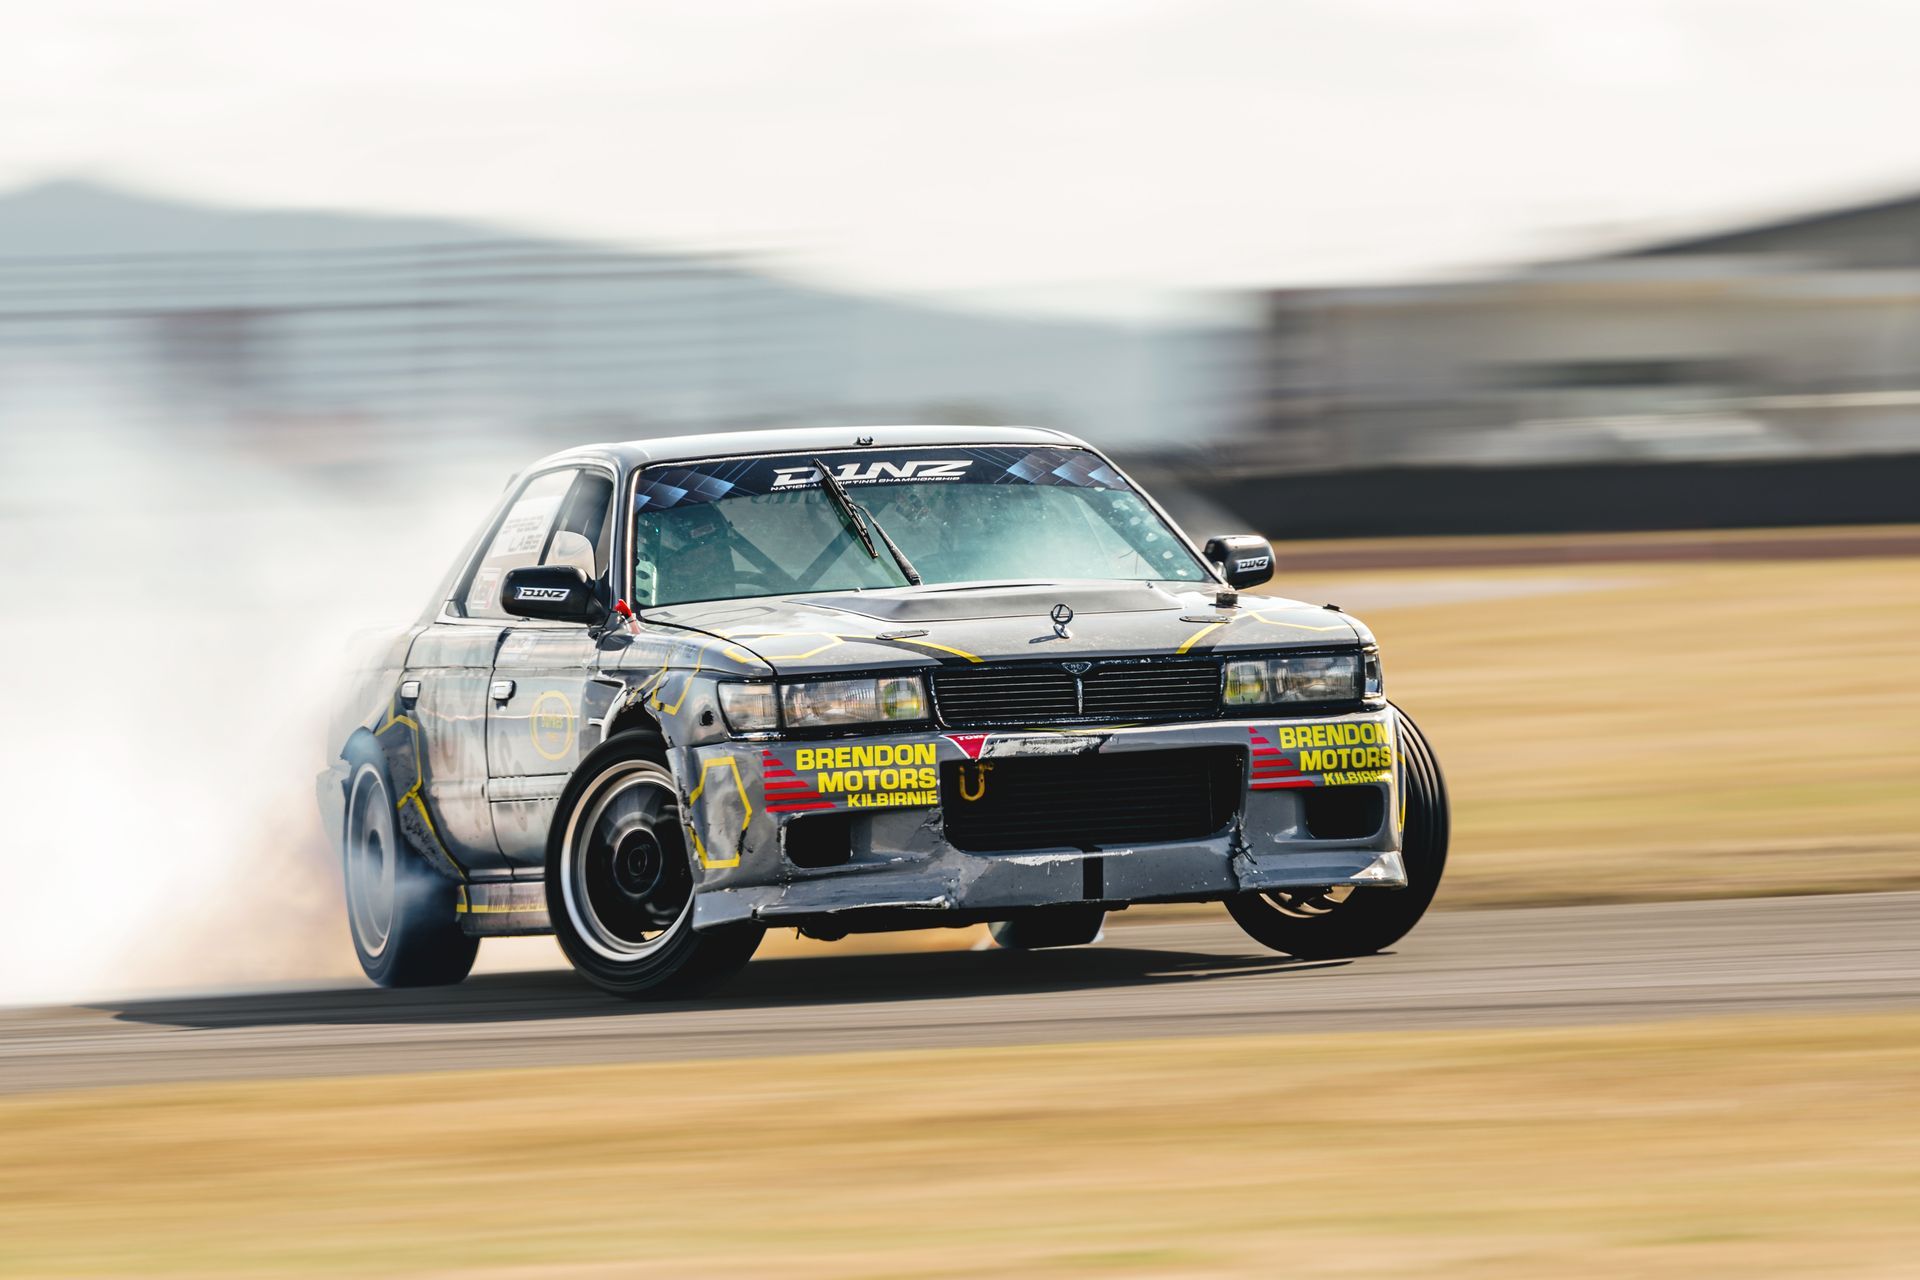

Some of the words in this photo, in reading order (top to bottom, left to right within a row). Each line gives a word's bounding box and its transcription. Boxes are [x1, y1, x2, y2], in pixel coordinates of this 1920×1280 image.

[773, 460, 973, 486] D1NZ
[1240, 559, 1266, 569] D1NZ
[522, 588, 567, 598] D1NZ
[1279, 723, 1390, 749] BRENDON
[796, 743, 936, 770] BRENDON
[1300, 746, 1393, 771] MOTORS
[817, 767, 937, 793] MOTORS
[1323, 769, 1392, 786] KILBIRN
[847, 790, 938, 807] KILBIRNIE
